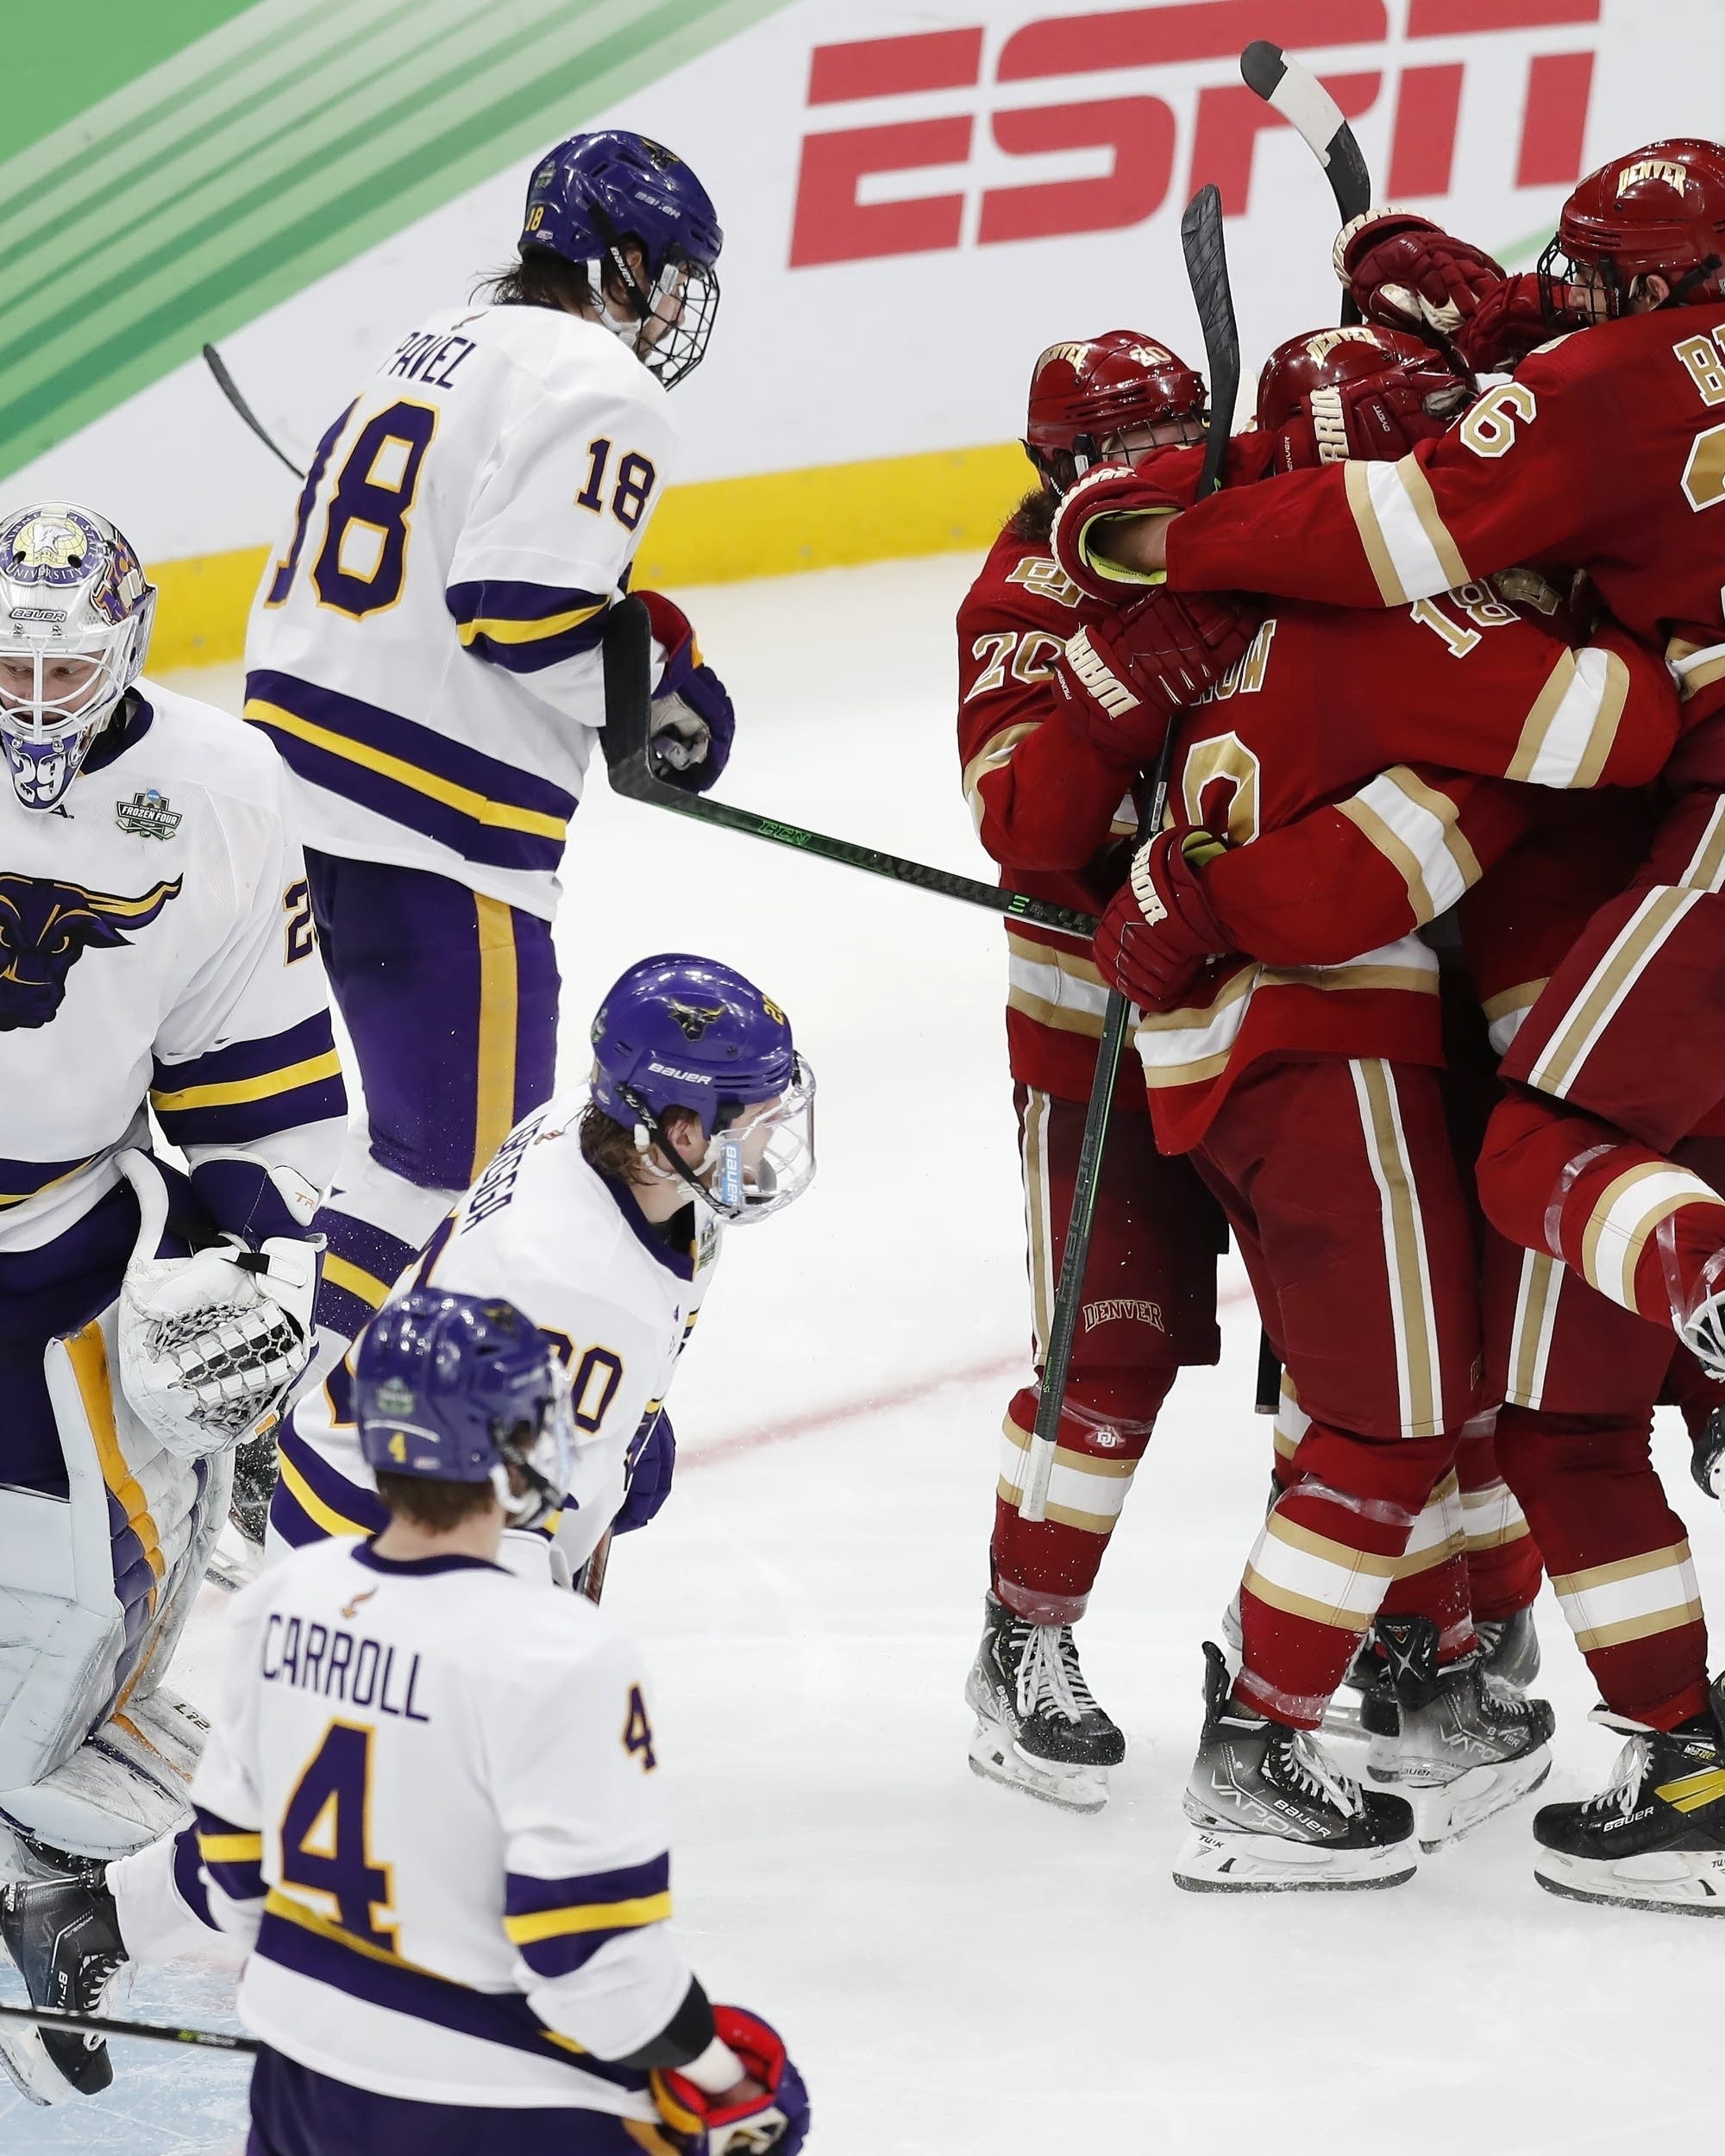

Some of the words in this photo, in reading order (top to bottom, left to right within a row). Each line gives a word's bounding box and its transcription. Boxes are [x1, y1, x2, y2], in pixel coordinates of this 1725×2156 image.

[787, 0, 1600, 269] ESPN
[1616, 160, 1687, 199] DENVER
[524, 206, 545, 232] 18
[375, 331, 477, 390] PAVEL
[1672, 323, 1725, 407] B
[1446, 380, 1538, 458] 6
[264, 391, 441, 623] 18
[573, 433, 659, 536] 18
[5, 563, 84, 580] UNIVERSITY
[12, 609, 66, 621] BAUER
[10, 748, 67, 804] 29
[121, 804, 156, 821] FROZEN
[155, 812, 178, 825] FOUR
[282, 876, 319, 967] 2
[648, 1062, 712, 1086] BAUER
[724, 1146, 739, 1204] BAUER
[1082, 1299, 1165, 1333] DENVER
[387, 1432, 407, 1463] 4
[261, 1613, 431, 1723] CARROLL
[622, 1682, 659, 1774] 4
[280, 1715, 401, 1957] 4
[1272, 1799, 1333, 1838] BAUER
[1603, 1806, 1655, 1833] BAUER
